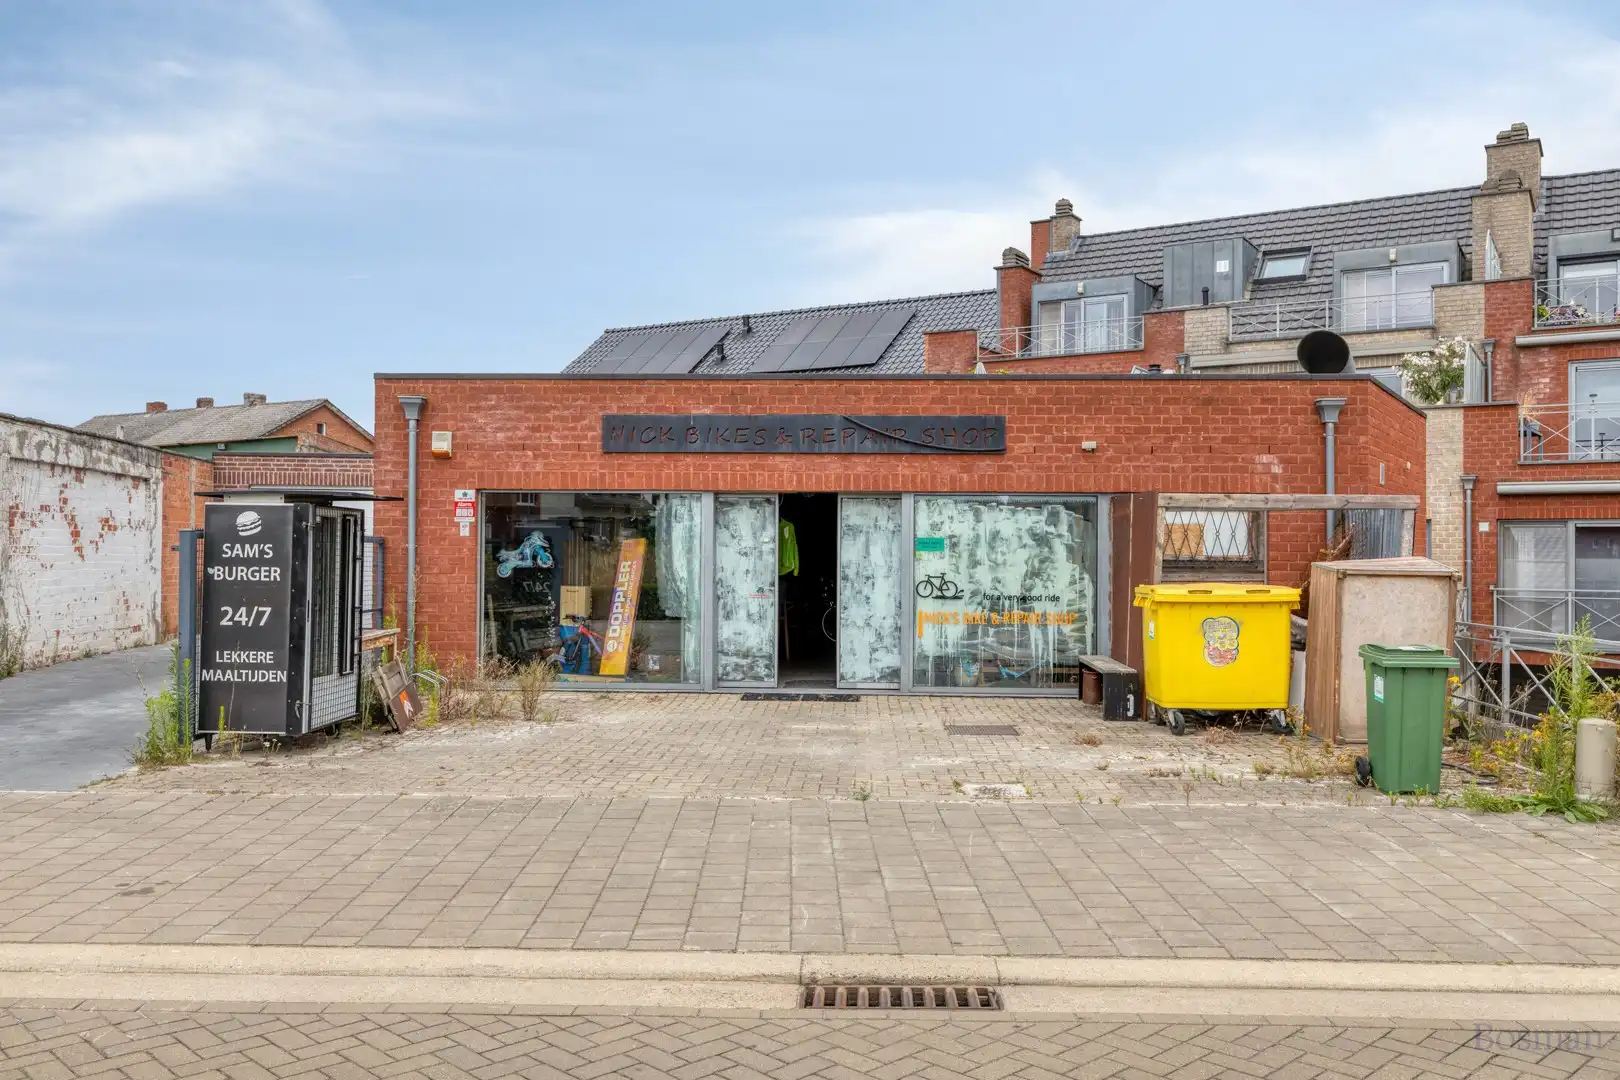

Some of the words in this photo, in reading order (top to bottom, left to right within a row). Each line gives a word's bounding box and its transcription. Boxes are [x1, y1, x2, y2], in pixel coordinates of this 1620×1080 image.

[610, 425, 675, 444] NICK
[685, 425, 767, 446] BIKES
[776, 426, 793, 445] &
[800, 426, 907, 445] REPAIR
[921, 426, 999, 447] SHOP
[222, 543, 274, 558] SAM'S
[213, 566, 281, 581] BURGER
[608, 560, 632, 638] DOPPLER
[983, 592, 995, 601] for
[1003, 593, 1022, 603] very
[1022, 593, 1043, 603] good
[1044, 593, 1061, 602] ride
[219, 606, 272, 627] 24/7
[991, 611, 1000, 625] &
[215, 650, 275, 664] LEKKERE
[201, 669, 287, 683] MAALTIJDEN
